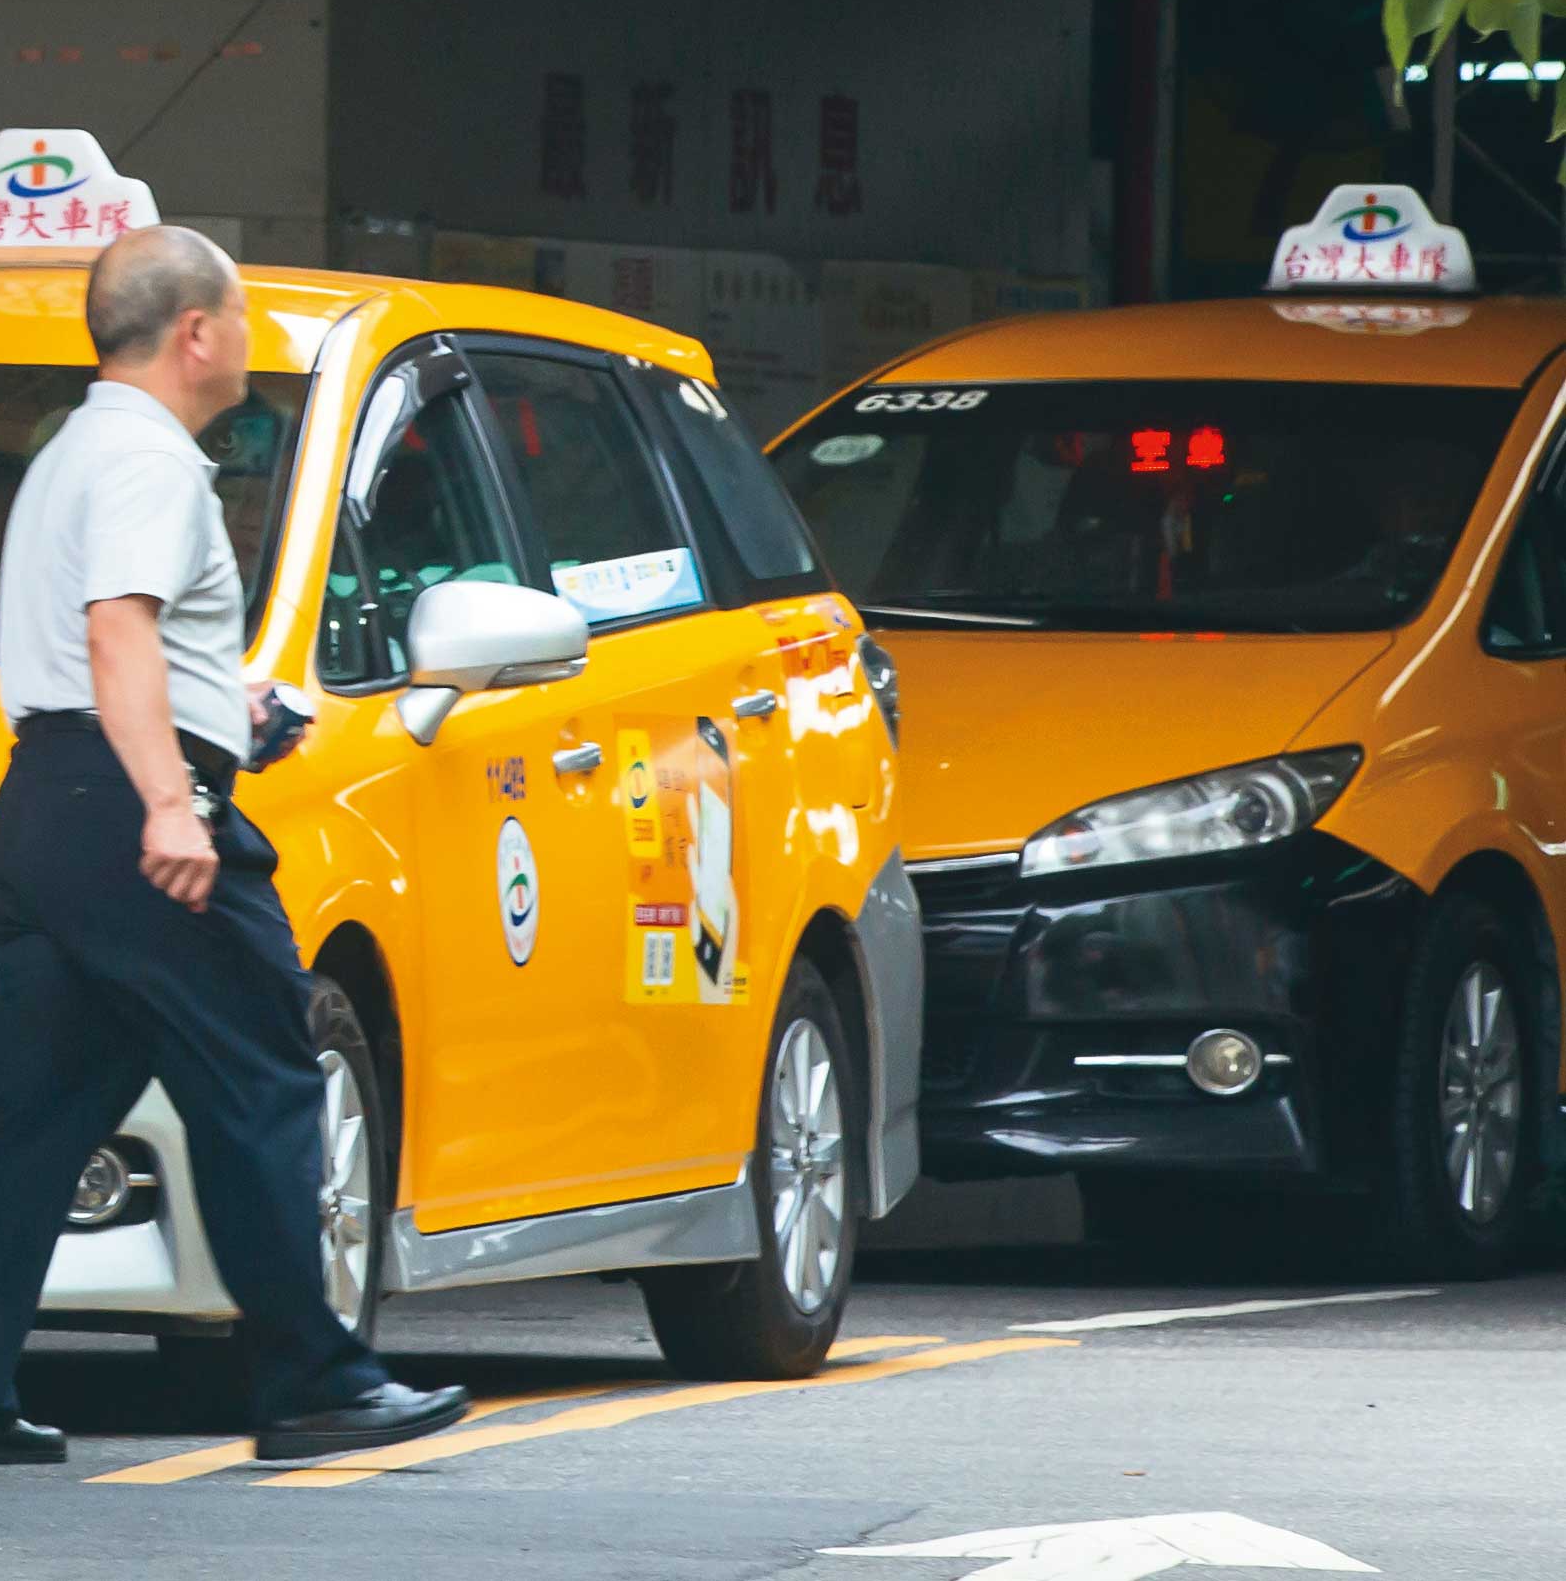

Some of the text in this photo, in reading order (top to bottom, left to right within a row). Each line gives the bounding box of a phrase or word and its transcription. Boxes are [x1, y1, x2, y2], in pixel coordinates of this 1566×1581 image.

[1283, 242, 1450, 283] 台灣大車隊
[854, 389, 989, 414] 6338
